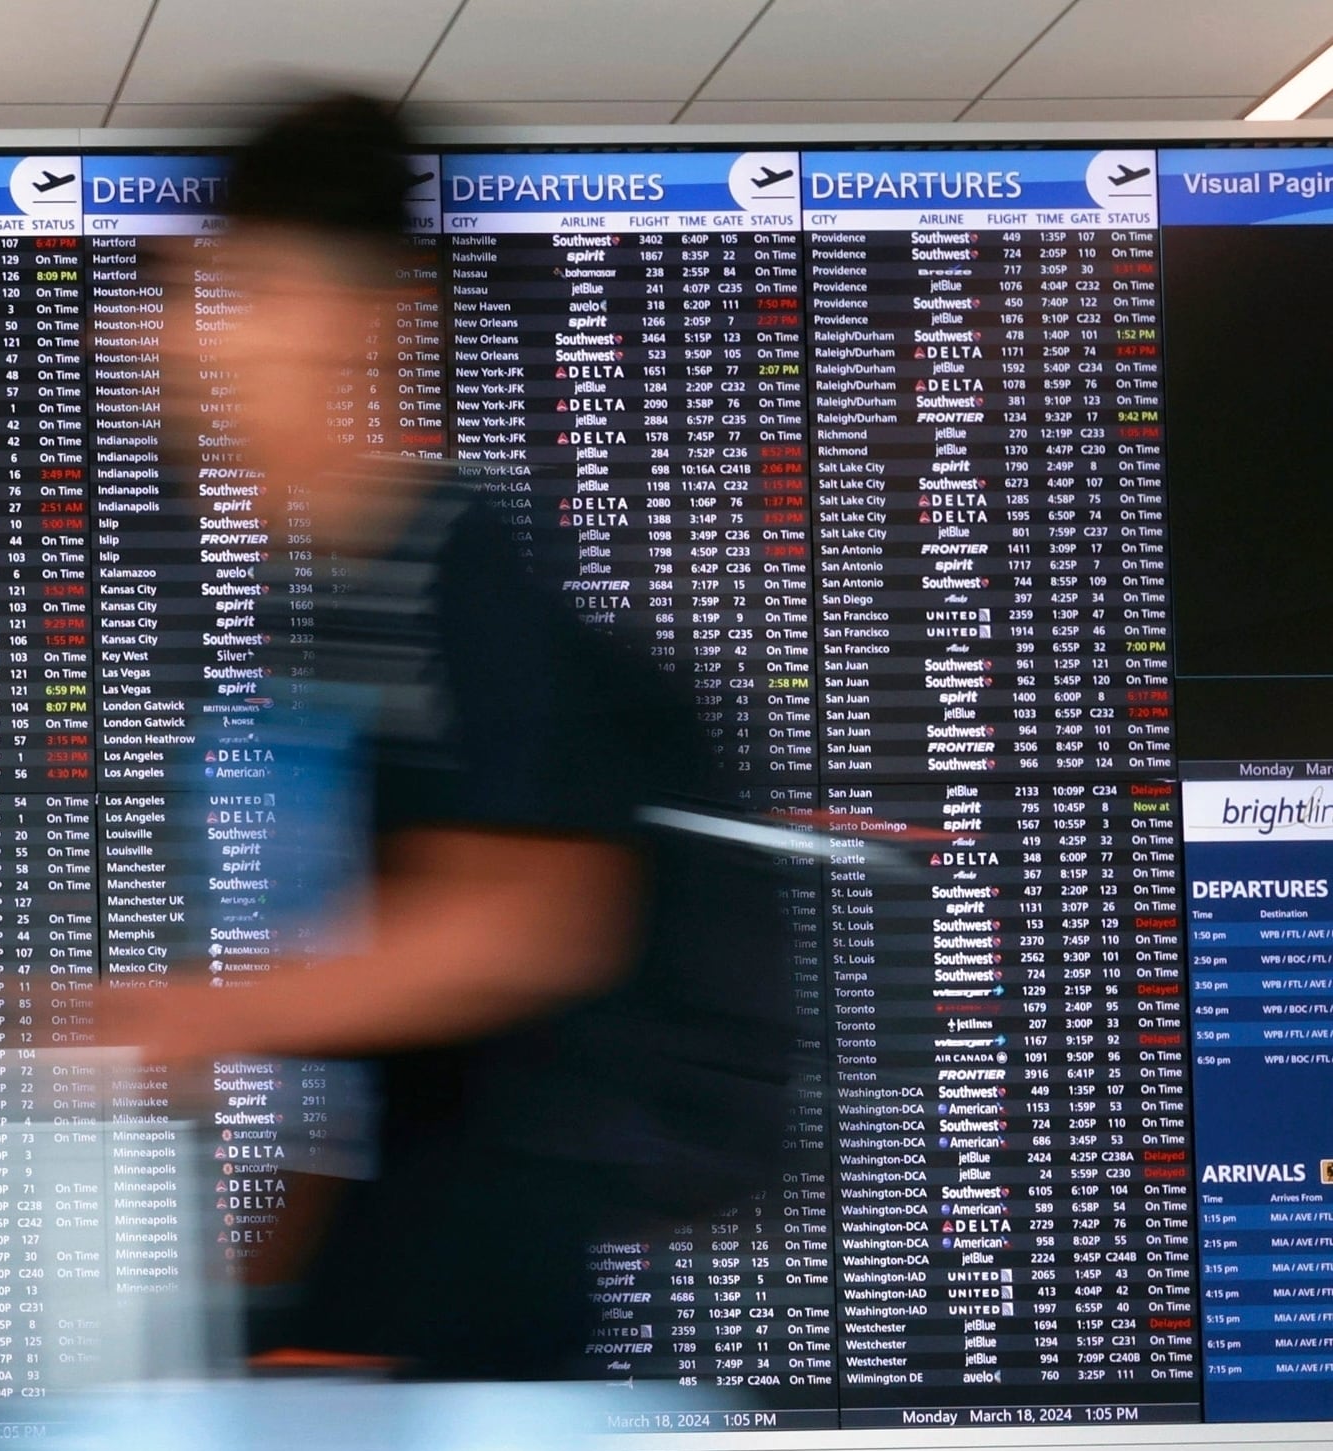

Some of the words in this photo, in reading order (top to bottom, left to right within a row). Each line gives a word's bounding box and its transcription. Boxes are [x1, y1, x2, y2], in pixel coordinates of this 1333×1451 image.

[92, 177, 228, 203] DEPART
[452, 174, 664, 202] DEPARTURES
[812, 171, 1021, 198] DEPARTURES
[1183, 172, 1259, 193] Visual
[2, 272, 19, 281] 126
[37, 272, 58, 280] 8:09
[61, 271, 77, 280] PM
[456, 368, 478, 377] New
[482, 368, 523, 376] York-JFK
[569, 366, 624, 378] DELTA
[644, 367, 665, 375] 1651
[687, 366, 712, 375] 1:56P
[727, 366, 738, 374] 77
[760, 365, 779, 374] 2:07
[783, 365, 798, 374] PM
[98, 469, 158, 480] Indianapolis
[819, 463, 837, 472] Salt
[840, 463, 863, 472] Lake
[866, 463, 884, 474] City
[1005, 462, 1028, 471] 1790
[1047, 462, 1074, 471] 2:49P
[1090, 461, 1097, 470] 8
[1119, 461, 1133, 470] On
[1136, 461, 1160, 470] Time
[1240, 763, 1293, 778] Monday
[1193, 880, 1328, 898] DEPARTURES
[1193, 911, 1212, 919] Time
[1261, 910, 1308, 918] Destination
[1194, 931, 1210, 939] 1:50
[1213, 933, 1226, 941] pm
[1287, 930, 1300, 938] FTL
[1308, 930, 1324, 938] AVE
[1202, 1164, 1305, 1183] ARRIVALS
[841, 1188, 927, 1200] Washington-DCA
[942, 1186, 1001, 1199] Southwest
[1029, 1186, 1052, 1196] 6105
[1072, 1186, 1098, 1195] 6:10P
[1111, 1185, 1128, 1194] 104
[1144, 1185, 1159, 1194] On
[1162, 1185, 1186, 1194] Time
[1203, 1195, 1223, 1203] Time
[1271, 1194, 1299, 1202] Arrives
[1223, 1216, 1236, 1224] pm
[1295, 1213, 1311, 1221] AVE
[1319, 1213, 1333, 1221] FTL
[903, 1410, 957, 1426] Monday
[971, 1409, 1011, 1422] March
[1017, 1409, 1035, 1422] 18,
[1040, 1409, 1072, 1421] 2024
[1086, 1408, 1112, 1420] 1:05
[1117, 1408, 1137, 1419] PM
